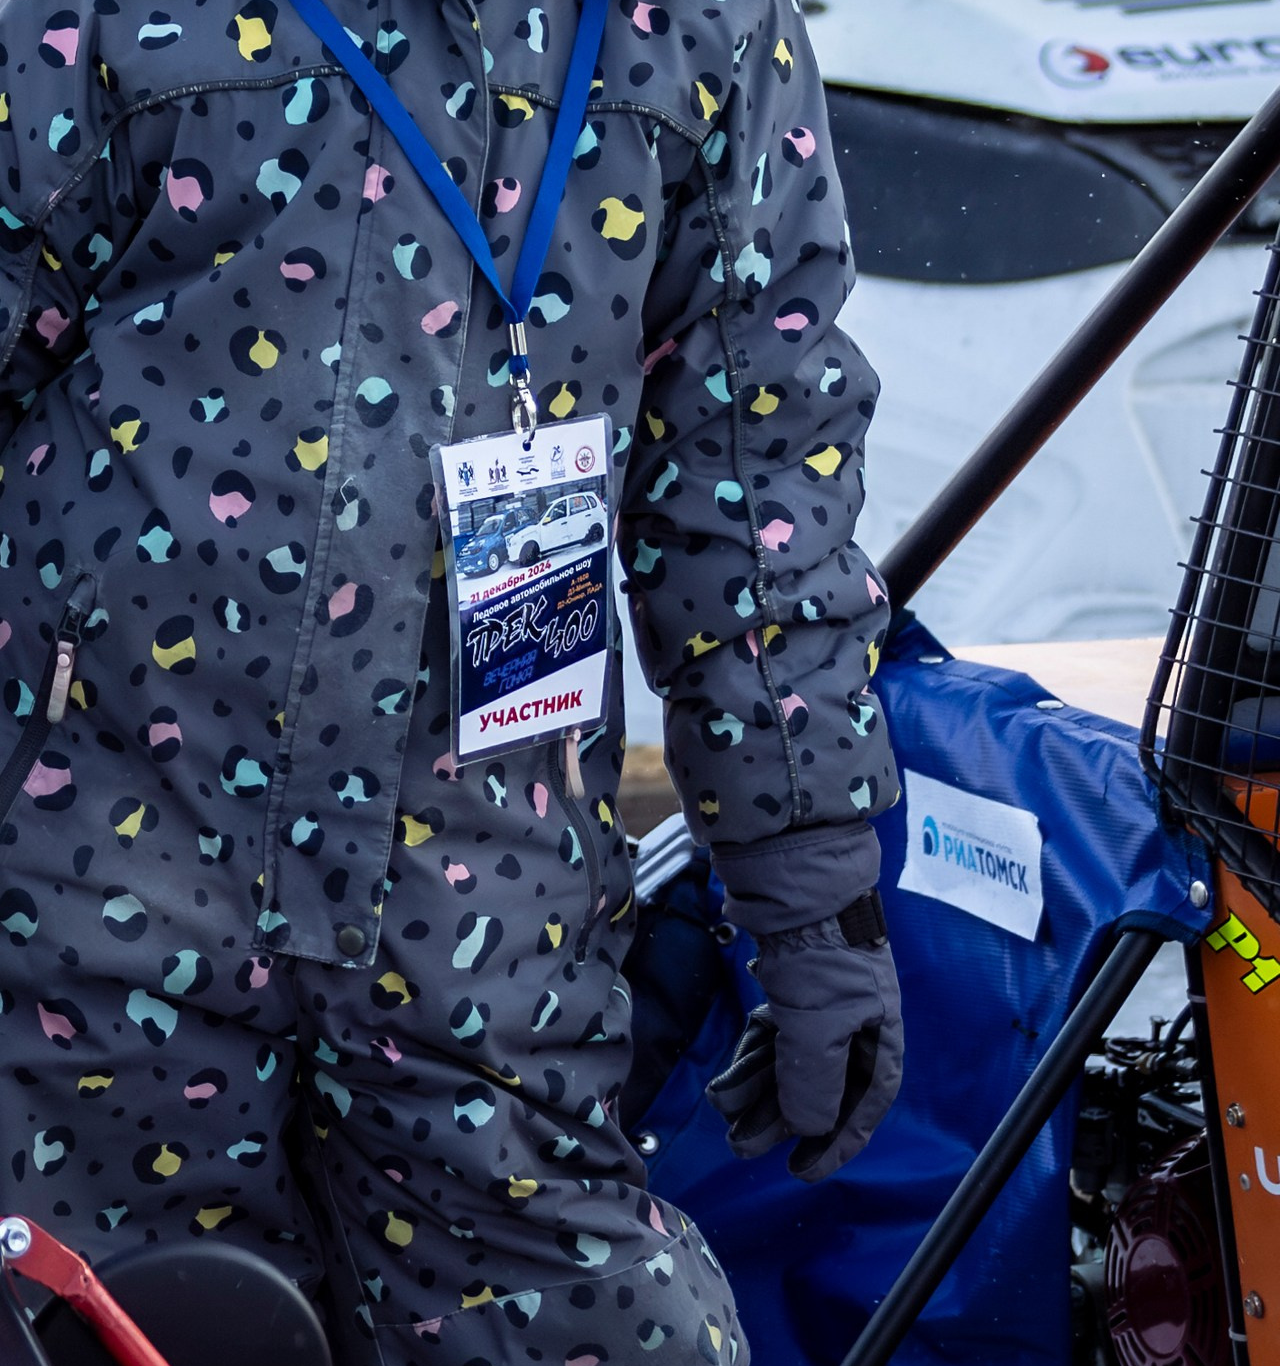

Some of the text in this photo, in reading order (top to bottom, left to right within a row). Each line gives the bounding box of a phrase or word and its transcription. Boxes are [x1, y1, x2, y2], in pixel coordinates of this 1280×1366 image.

[470, 559, 552, 604] 21 декабря 2024
[472, 557, 592, 623] Ледовое автомобильное шоу
[466, 594, 599, 668] ТРЕК 400
[478, 689, 584, 733] УЧАСТНИК
[943, 833, 1029, 895] РИАТОМСК
